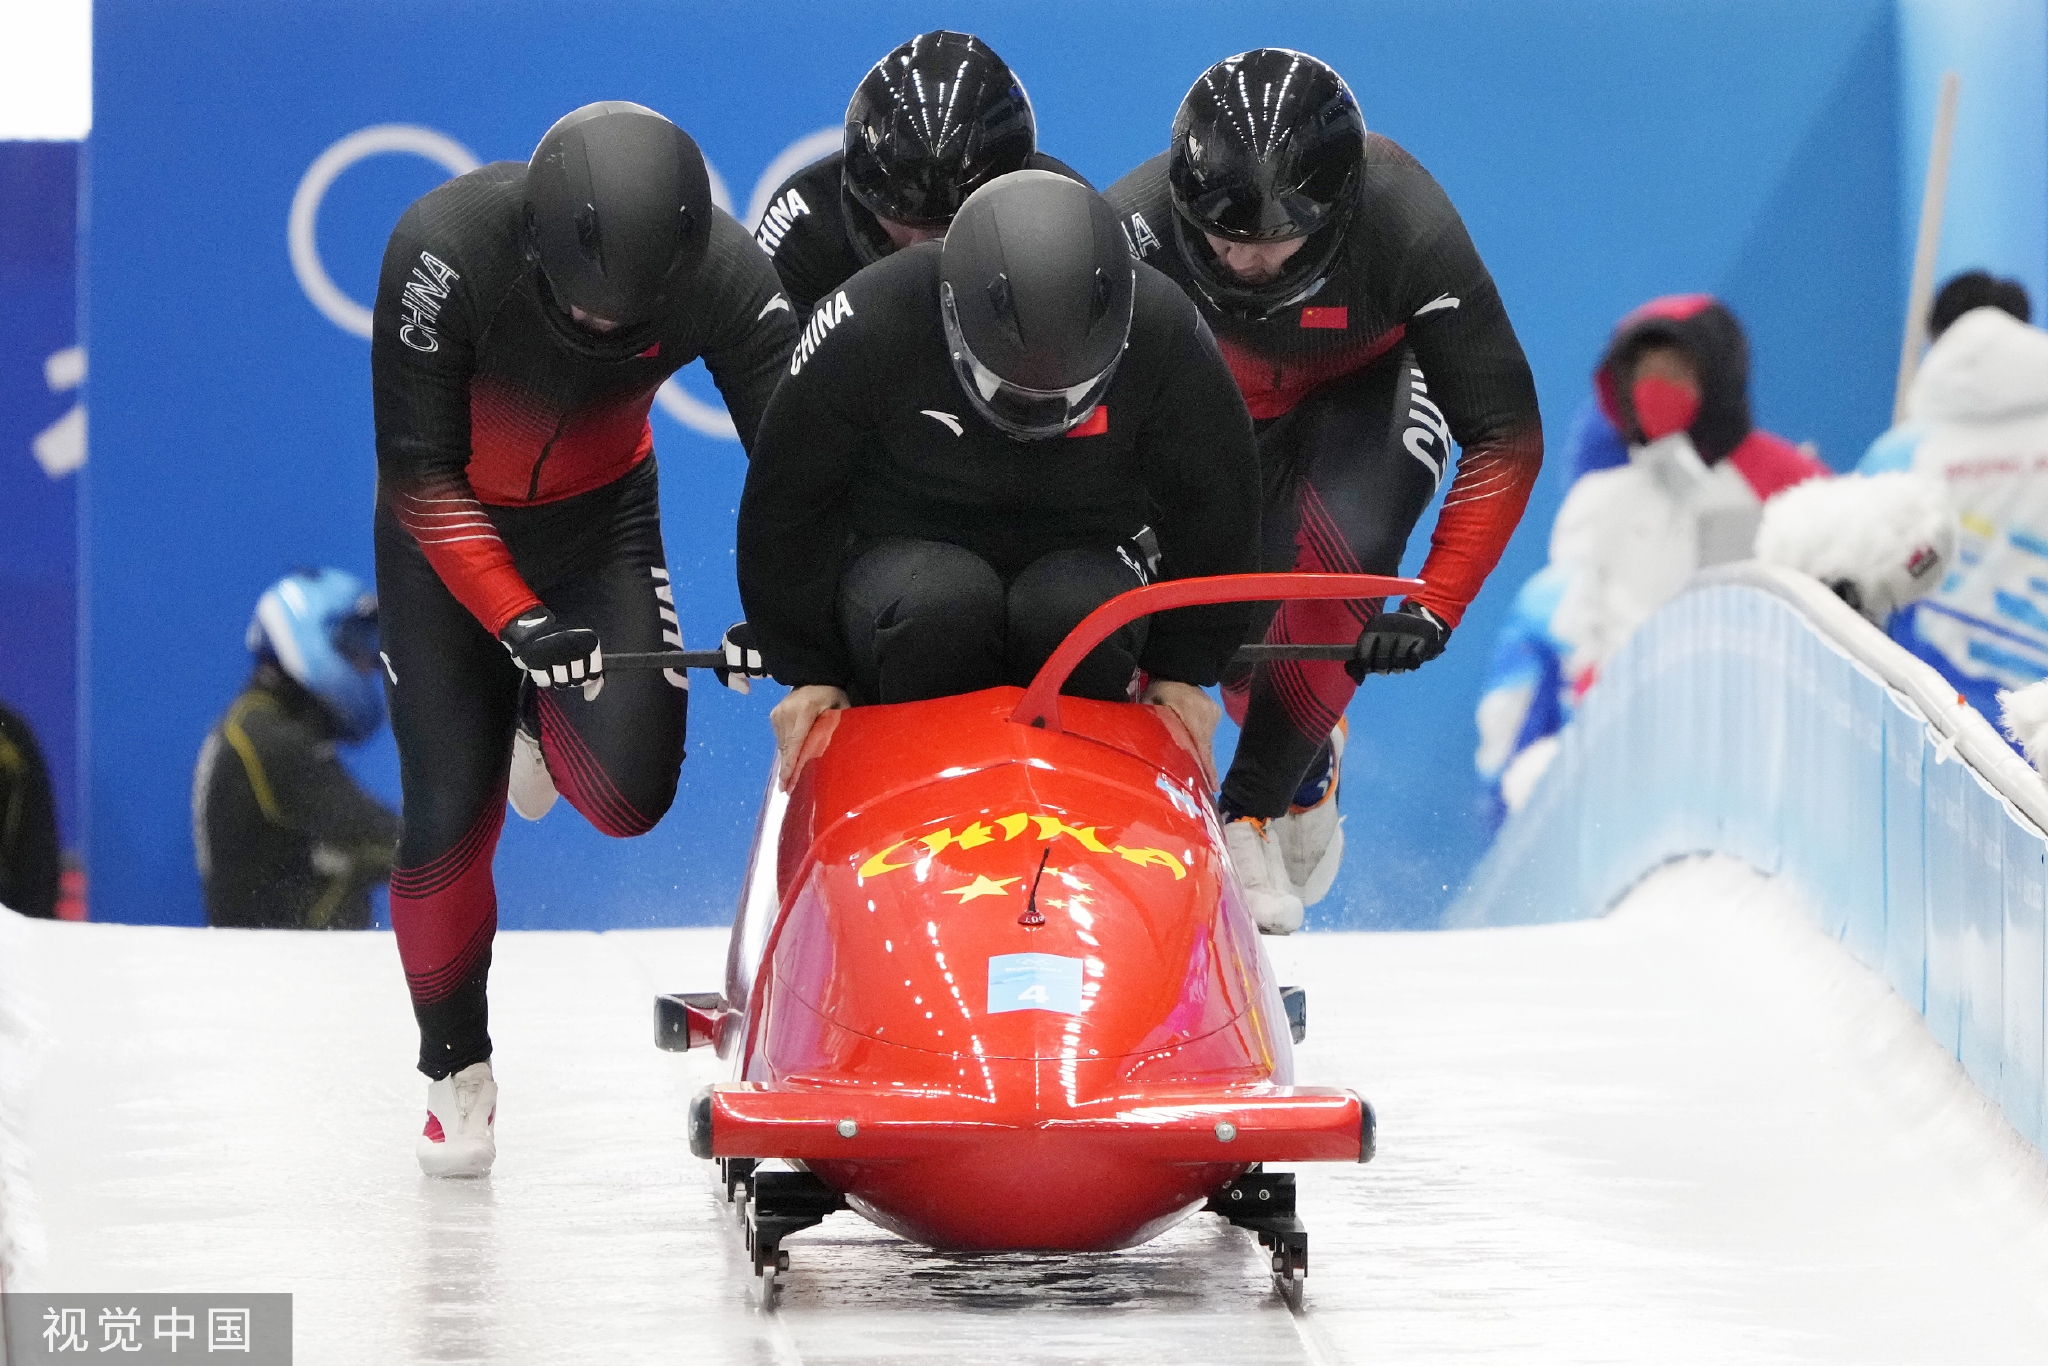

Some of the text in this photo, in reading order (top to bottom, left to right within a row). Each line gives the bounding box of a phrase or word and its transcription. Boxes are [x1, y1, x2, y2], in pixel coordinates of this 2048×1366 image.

[757, 188, 811, 260] HINA
[400, 250, 460, 352] CHINA
[790, 290, 854, 376] CHINA
[1018, 984, 1049, 1003] 4
